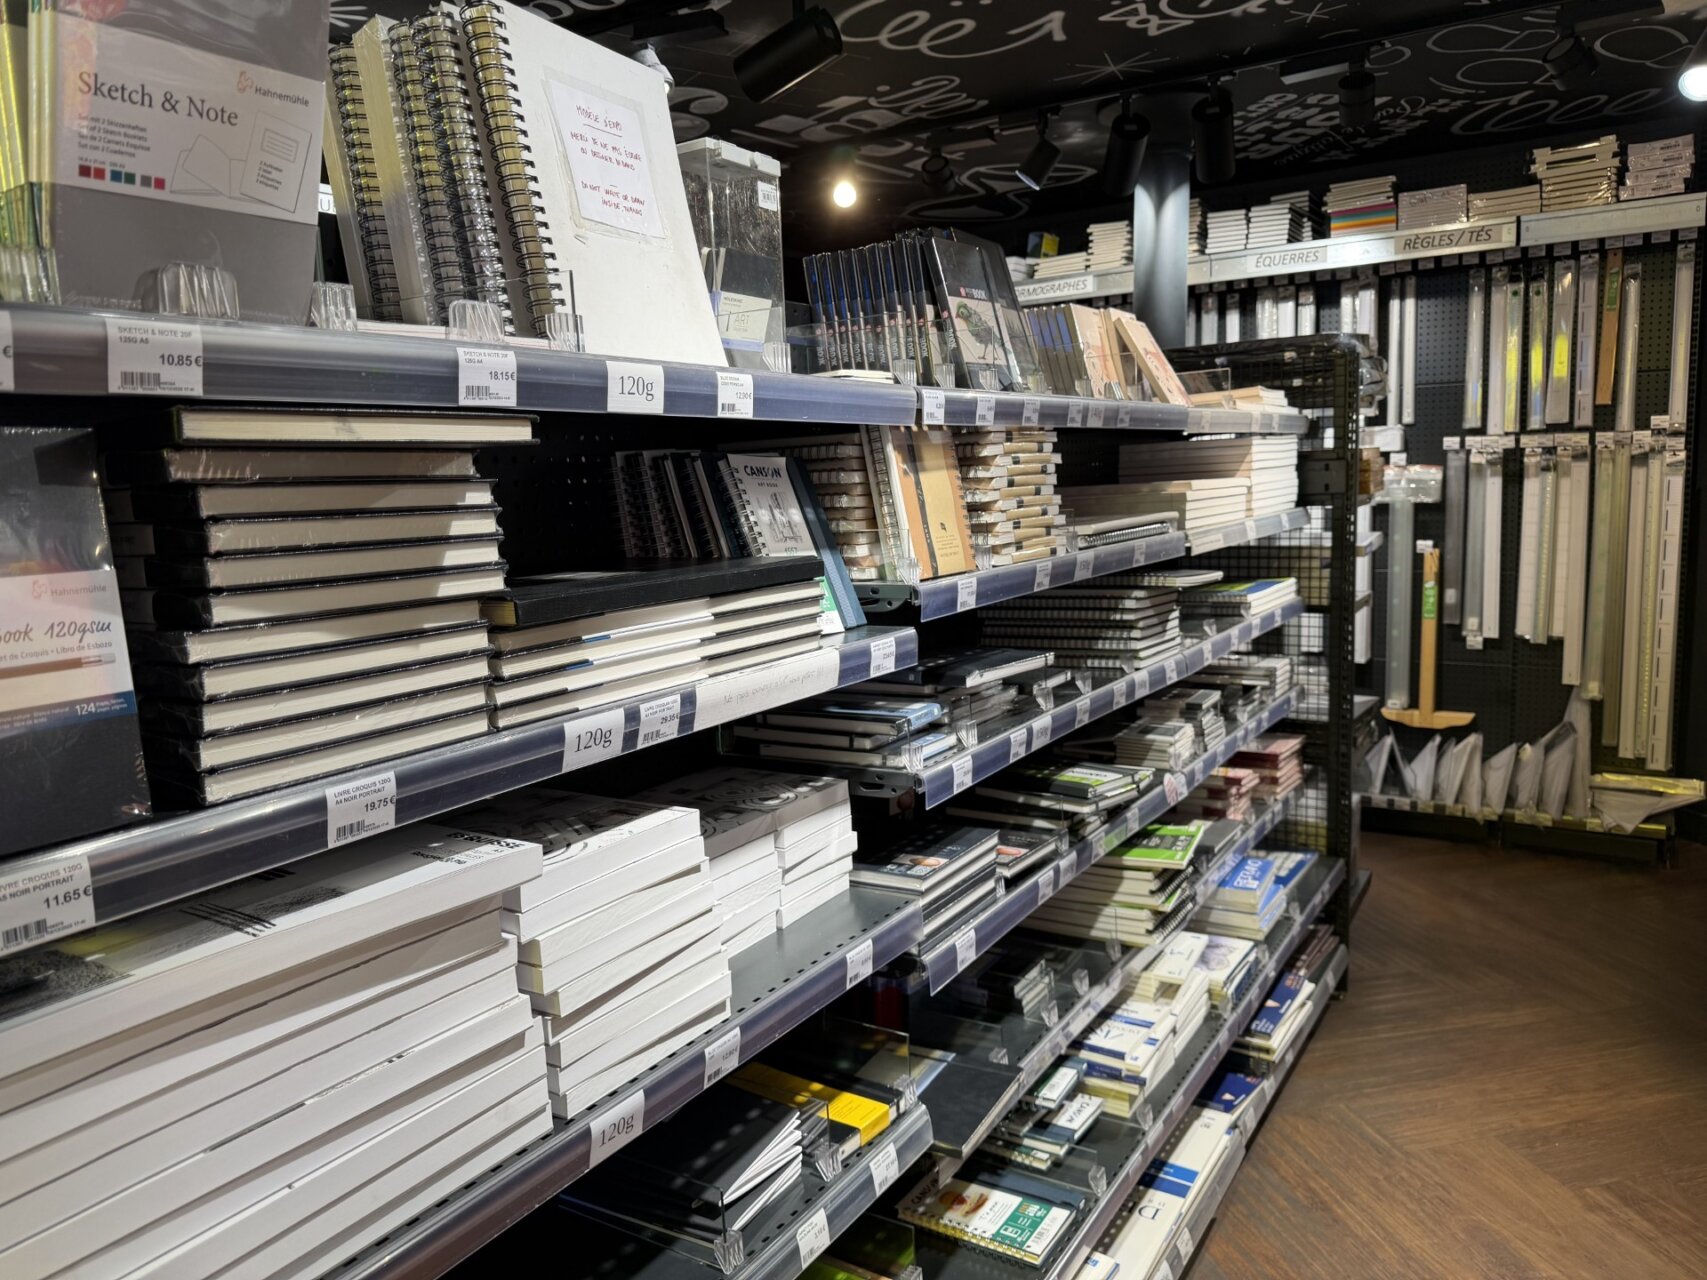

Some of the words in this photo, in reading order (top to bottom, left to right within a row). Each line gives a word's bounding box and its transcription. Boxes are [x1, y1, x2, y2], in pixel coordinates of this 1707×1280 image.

[78, 71, 153, 108] Sketch
[161, 91, 180, 114] &
[186, 96, 238, 126] Note
[255, 86, 309, 107] Hahnemühle
[1403, 232, 1454, 251] RÈGLES
[1468, 227, 1493, 243] TÉS
[1255, 250, 1320, 269] ÉQUERRES
[118, 327, 149, 336] SKETCH
[151, 328, 156, 336] &
[158, 329, 178, 337] NOTE
[119, 336, 138, 344] 125G
[159, 354, 193, 367] 10.85
[488, 371, 510, 381] 18.15
[618, 375, 655, 401] 120g
[744, 465, 782, 478] CANSON
[51, 584, 107, 596] Hahnemühle
[44, 620, 112, 644] 120gsm
[20, 649, 49, 659] Croquis
[56, 646, 76, 655] Libro
[87, 641, 113, 650] Esbozo
[75, 701, 96, 716] 124
[574, 727, 612, 753] 120g
[334, 788, 351, 799] LIVRE
[352, 782, 378, 793] CROQUIS
[378, 777, 391, 786] 120G
[343, 794, 358, 803] NOIR
[359, 787, 385, 799] PORTRAIT
[364, 797, 389, 813] 19.75
[22, 869, 60, 886] CROQUIS
[63, 863, 82, 874] 120G
[9, 887, 31, 900] NOIR
[33, 874, 74, 892] PORTRAIT
[44, 888, 81, 909] 11.65
[600, 1113, 635, 1148] 120g
